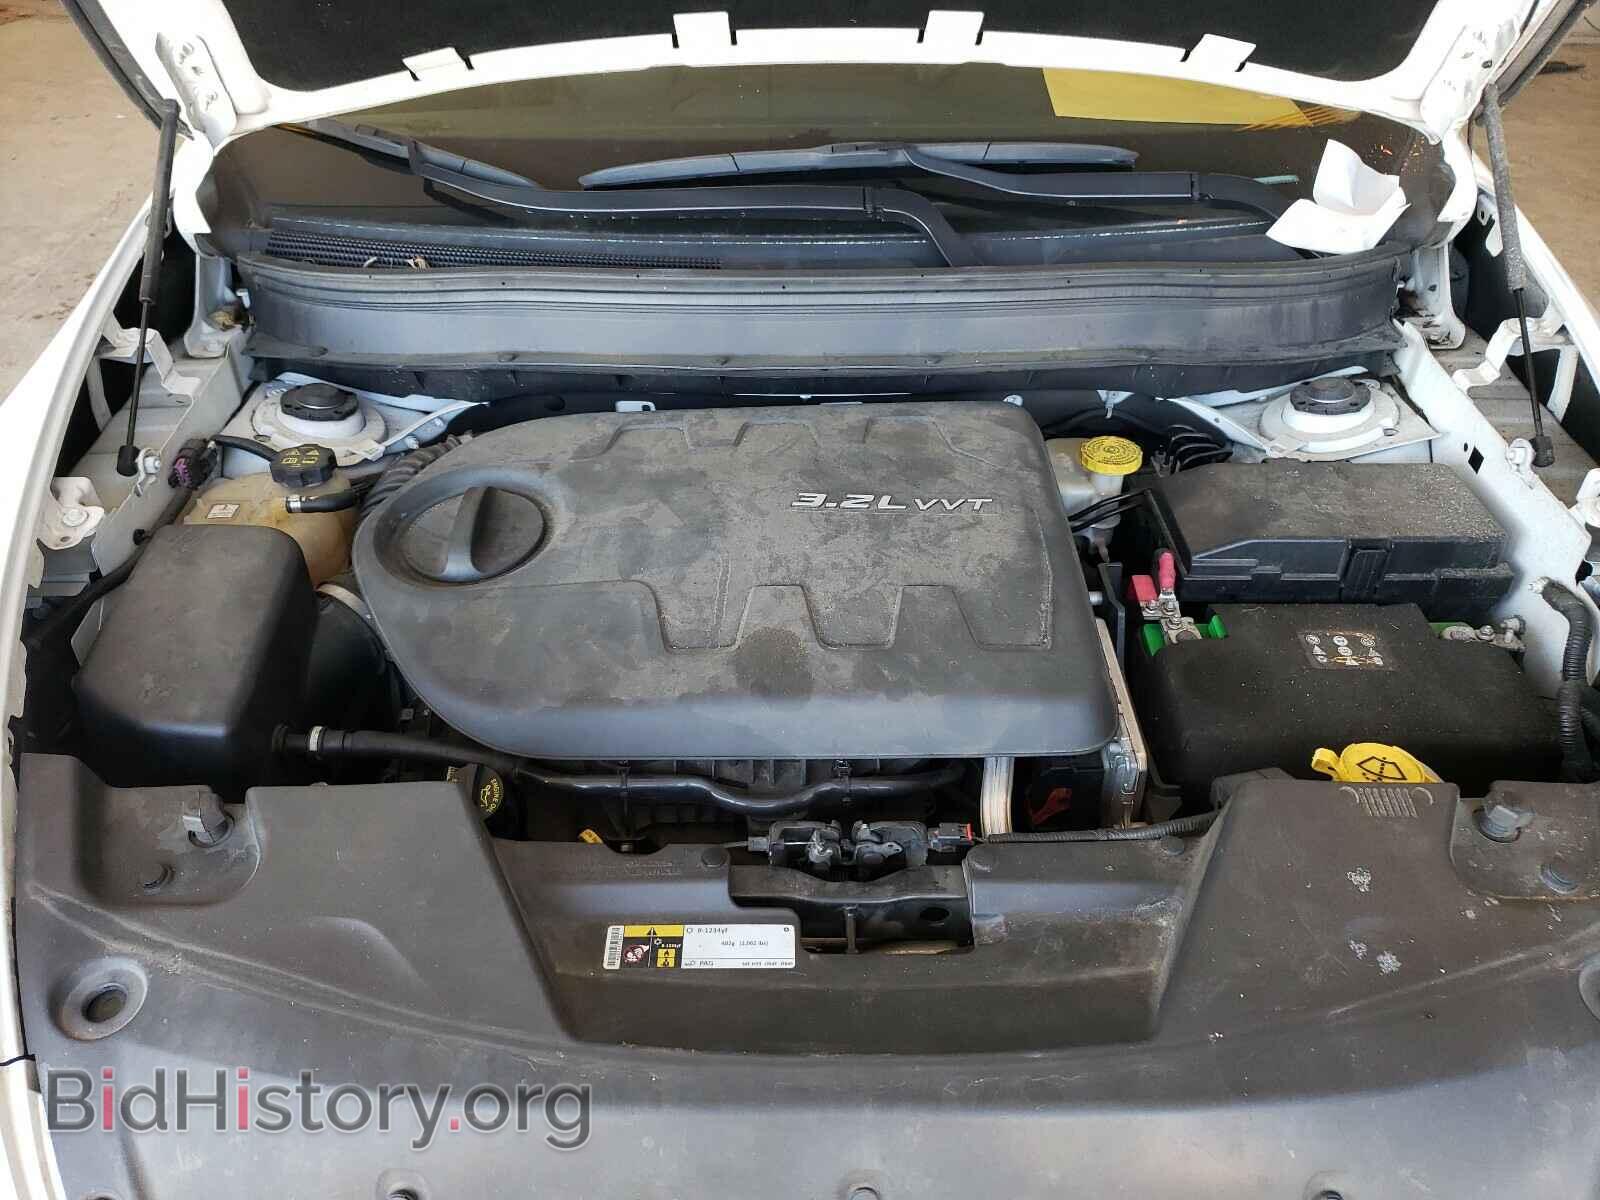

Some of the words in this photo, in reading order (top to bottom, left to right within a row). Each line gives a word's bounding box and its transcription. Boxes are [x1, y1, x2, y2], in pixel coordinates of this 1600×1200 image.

[791, 492, 907, 510] 3.2L
[914, 498, 993, 511] VVT
[490, 778, 500, 802] ENGINE
